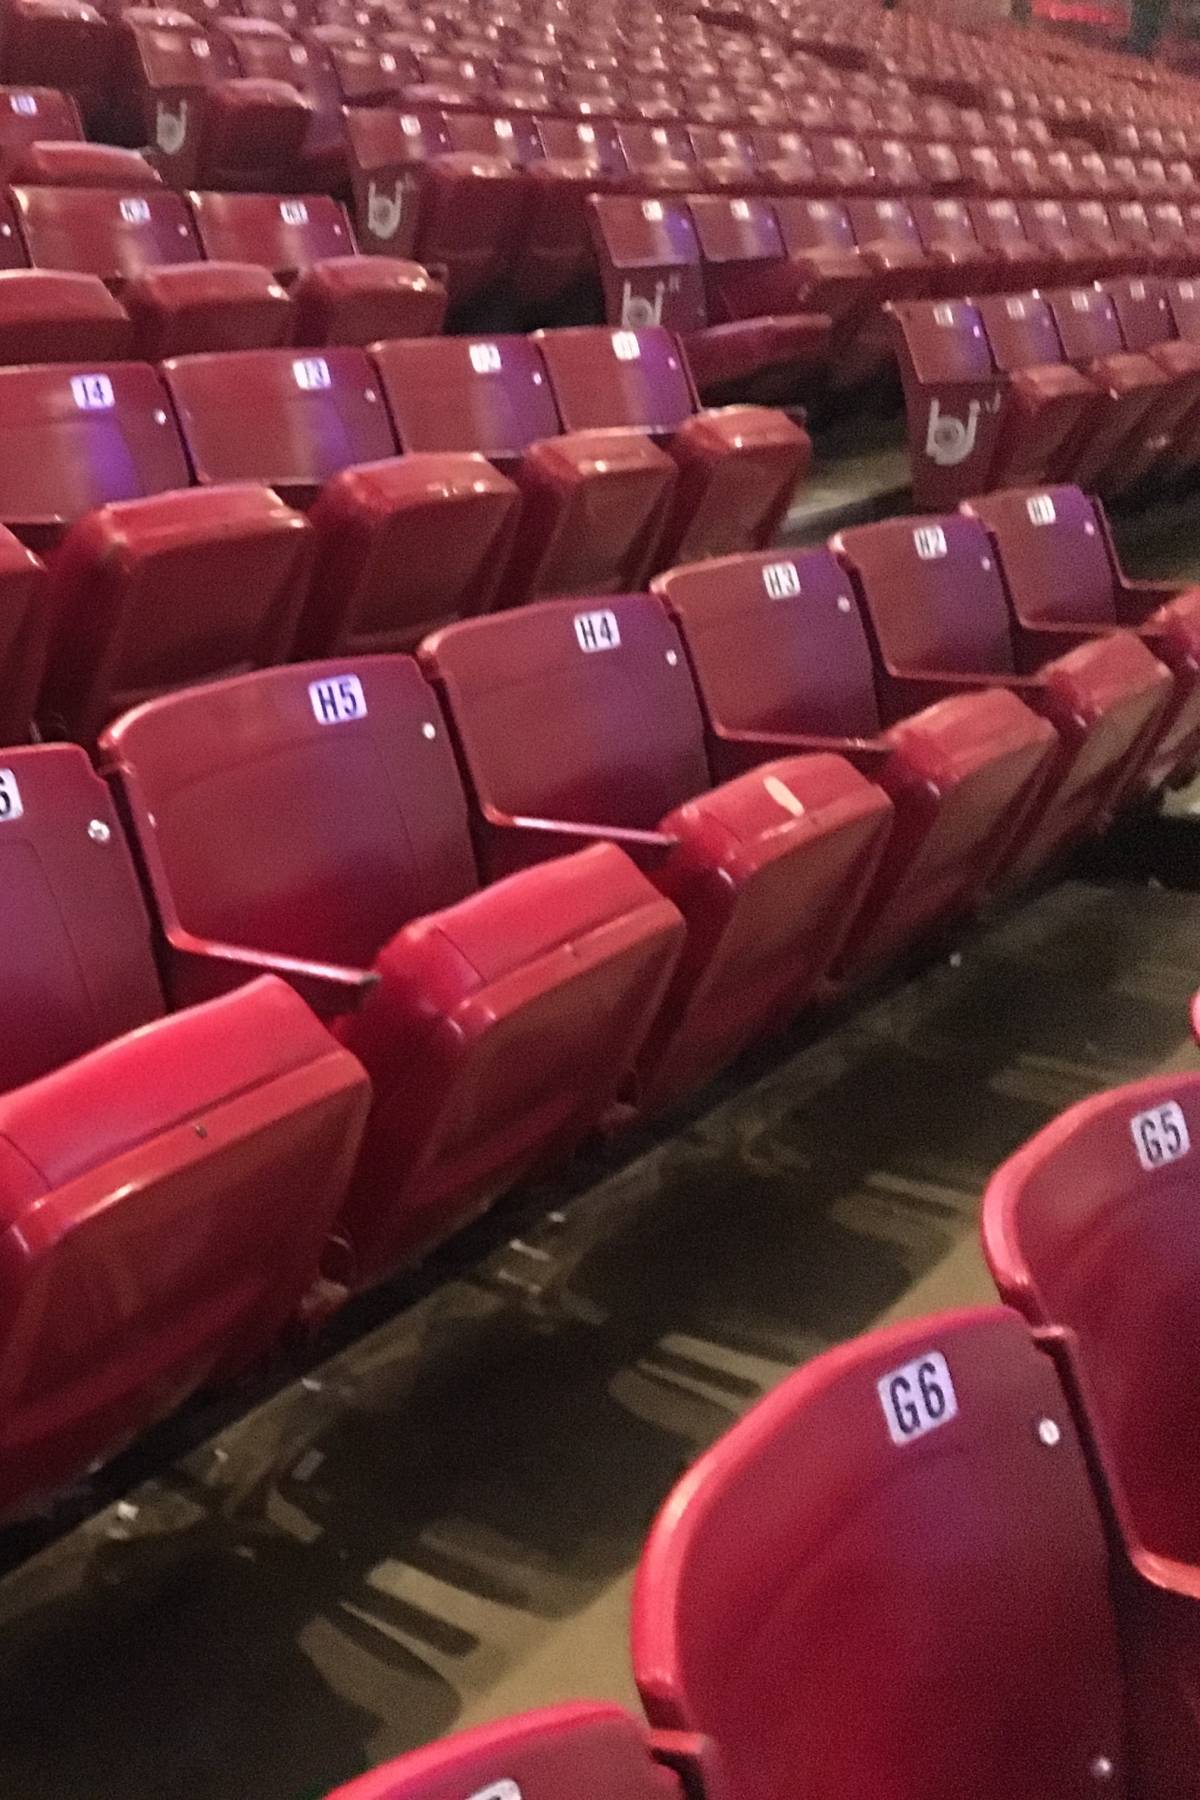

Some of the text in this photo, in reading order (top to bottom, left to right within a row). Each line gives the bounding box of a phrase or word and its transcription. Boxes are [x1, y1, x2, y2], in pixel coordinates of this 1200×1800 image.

[915, 527, 943, 557] H2
[766, 566, 796, 596] H3
[578, 616, 614, 649] H4
[316, 676, 357, 720] H5
[1138, 1109, 1180, 1164] G5
[888, 1361, 945, 1435] G6
